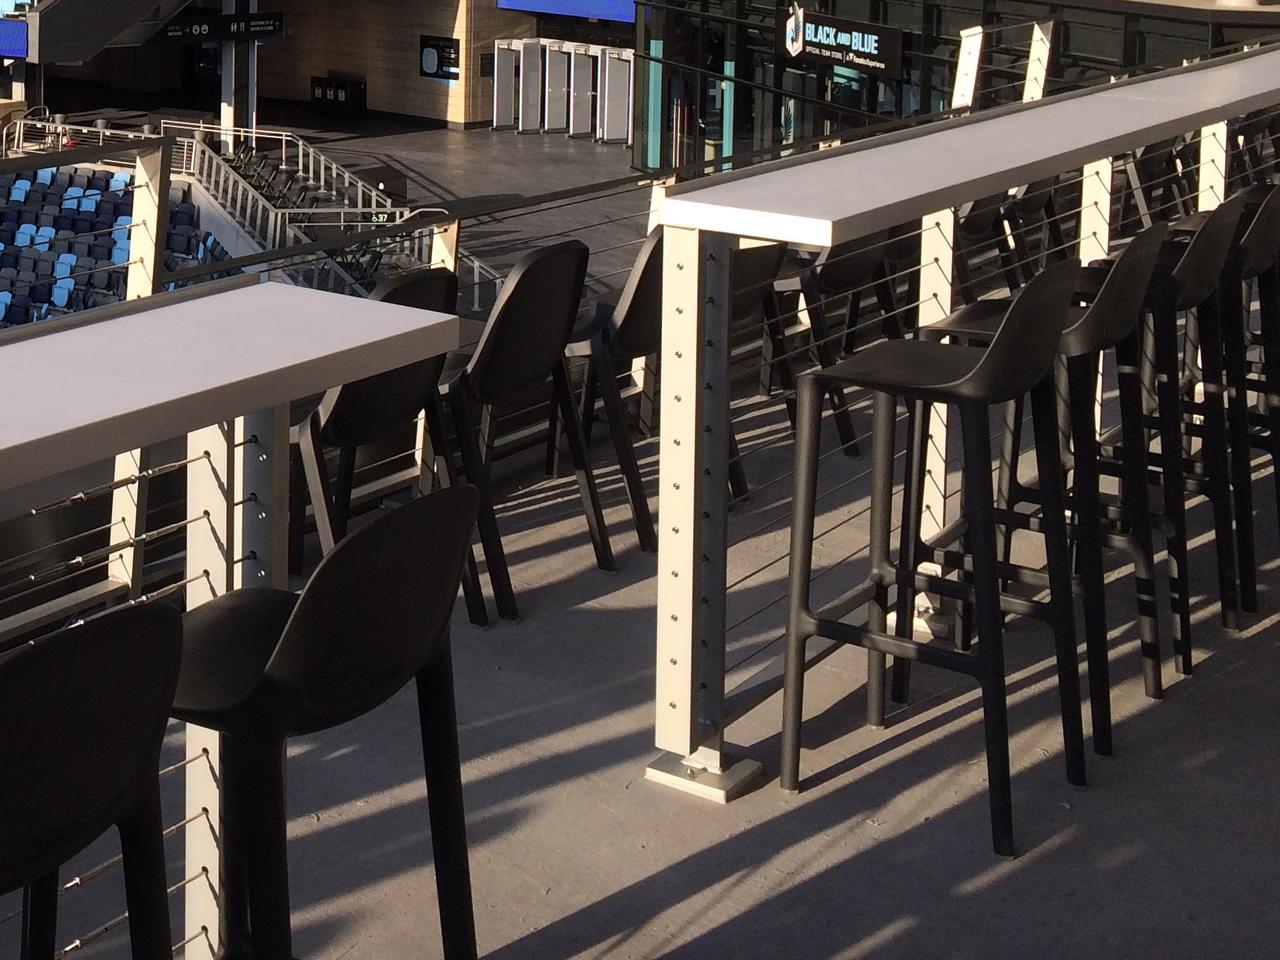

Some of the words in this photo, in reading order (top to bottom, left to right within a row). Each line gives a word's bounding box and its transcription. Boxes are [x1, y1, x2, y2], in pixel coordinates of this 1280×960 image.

[805, 23, 837, 46] BLACK
[837, 31, 851, 46] AND
[851, 31, 879, 55] BLUE
[377, 213, 388, 222] 37
